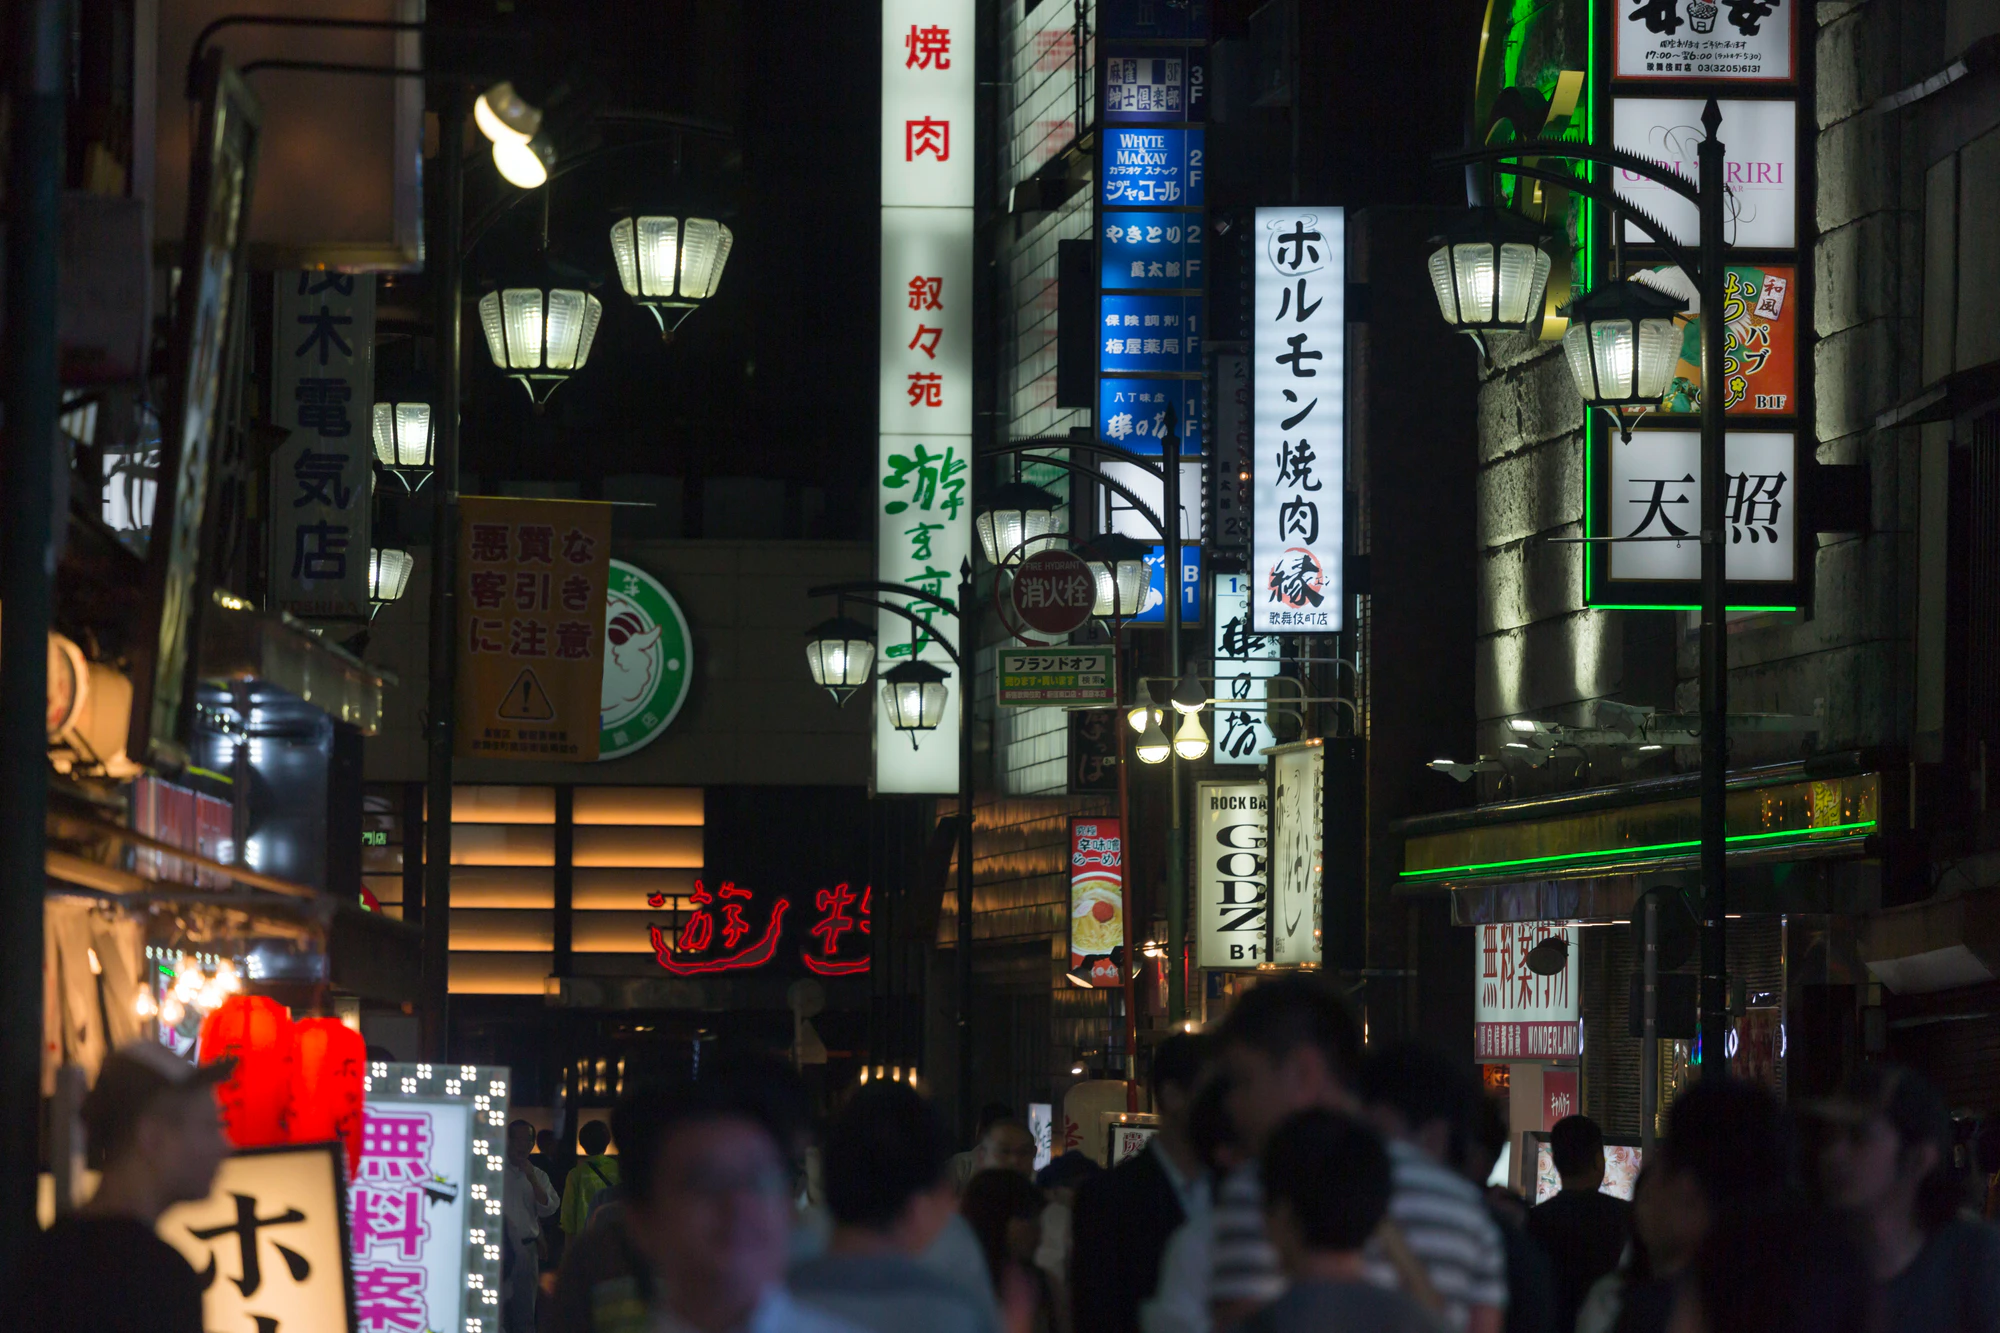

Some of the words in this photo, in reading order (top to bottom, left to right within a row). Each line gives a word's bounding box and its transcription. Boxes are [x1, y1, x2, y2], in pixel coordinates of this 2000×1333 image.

[1647, 62, 1692, 72] 歌舞伎町店
[1697, 63, 1761, 73] 03(3205)6131
[905, 24, 951, 162] 焼肉
[1190, 66, 1204, 104] 3F
[1116, 151, 1168, 165] MACKAY
[1119, 134, 1165, 148] WHYTE
[1109, 166, 1142, 175] カラオケ
[1144, 166, 1178, 175] スナック
[1190, 150, 1202, 187] 2F
[1106, 180, 1181, 201] ジャコール
[1106, 225, 1181, 244] やきとり
[1186, 225, 1201, 278] 2F
[1759, 278, 1784, 317] 和風
[1105, 314, 1179, 327] 保険調剤
[1187, 315, 1199, 354] 1F
[907, 275, 944, 408] 叙々苑
[1105, 338, 1180, 354] 梅屋薬局
[1744, 325, 1771, 375] パブ
[1274, 220, 1323, 545] ホルモン焼肉
[1185, 399, 1198, 437] 1F
[1755, 395, 1787, 409] B1F
[1626, 471, 1788, 544] 天照
[471, 524, 597, 565] 悪質な
[1026, 562, 1042, 571] FIRE
[1045, 561, 1081, 571] HYDRANT
[469, 571, 593, 612] 客引き
[1020, 575, 1089, 609] 消火栓
[1183, 565, 1199, 604] B1
[1269, 612, 1328, 626] 歌舞伎町店
[470, 617, 594, 660] に注意
[1013, 658, 1097, 671] ブランドオフ
[1210, 796, 1246, 810] ROCK
[1230, 944, 1258, 960] B1
[1527, 1025, 1577, 1055] WONDERLAND
